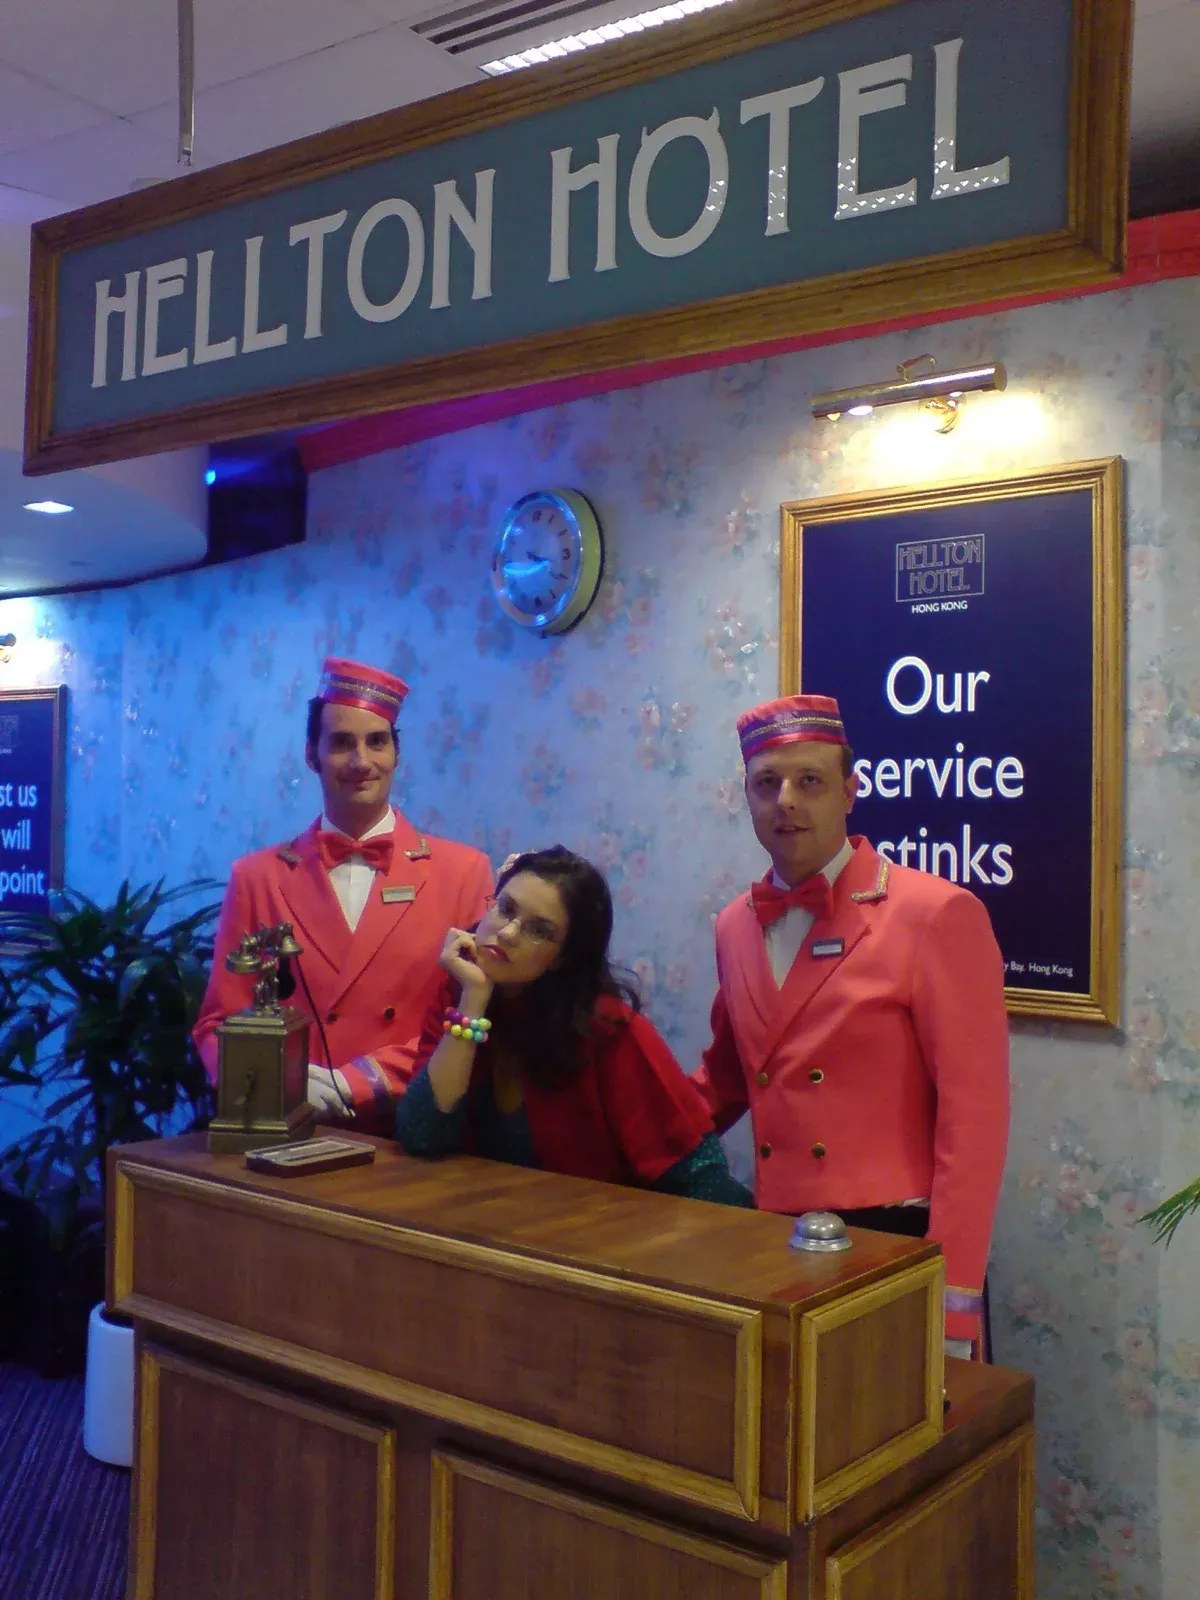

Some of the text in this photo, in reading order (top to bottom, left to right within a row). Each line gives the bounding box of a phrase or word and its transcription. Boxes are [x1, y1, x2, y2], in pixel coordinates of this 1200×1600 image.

[91, 38, 1011, 389] HELLTON HOTEL
[899, 539, 981, 571] HELLTON
[909, 567, 970, 595] HOTEL
[911, 600, 968, 614] HONG KONG
[886, 655, 991, 715] Our
[853, 742, 1025, 798] service
[18, 784, 37, 807] us
[1, 819, 31, 851] will
[1028, 962, 1051, 976] Hong
[1052, 964, 1073, 978] Kong
